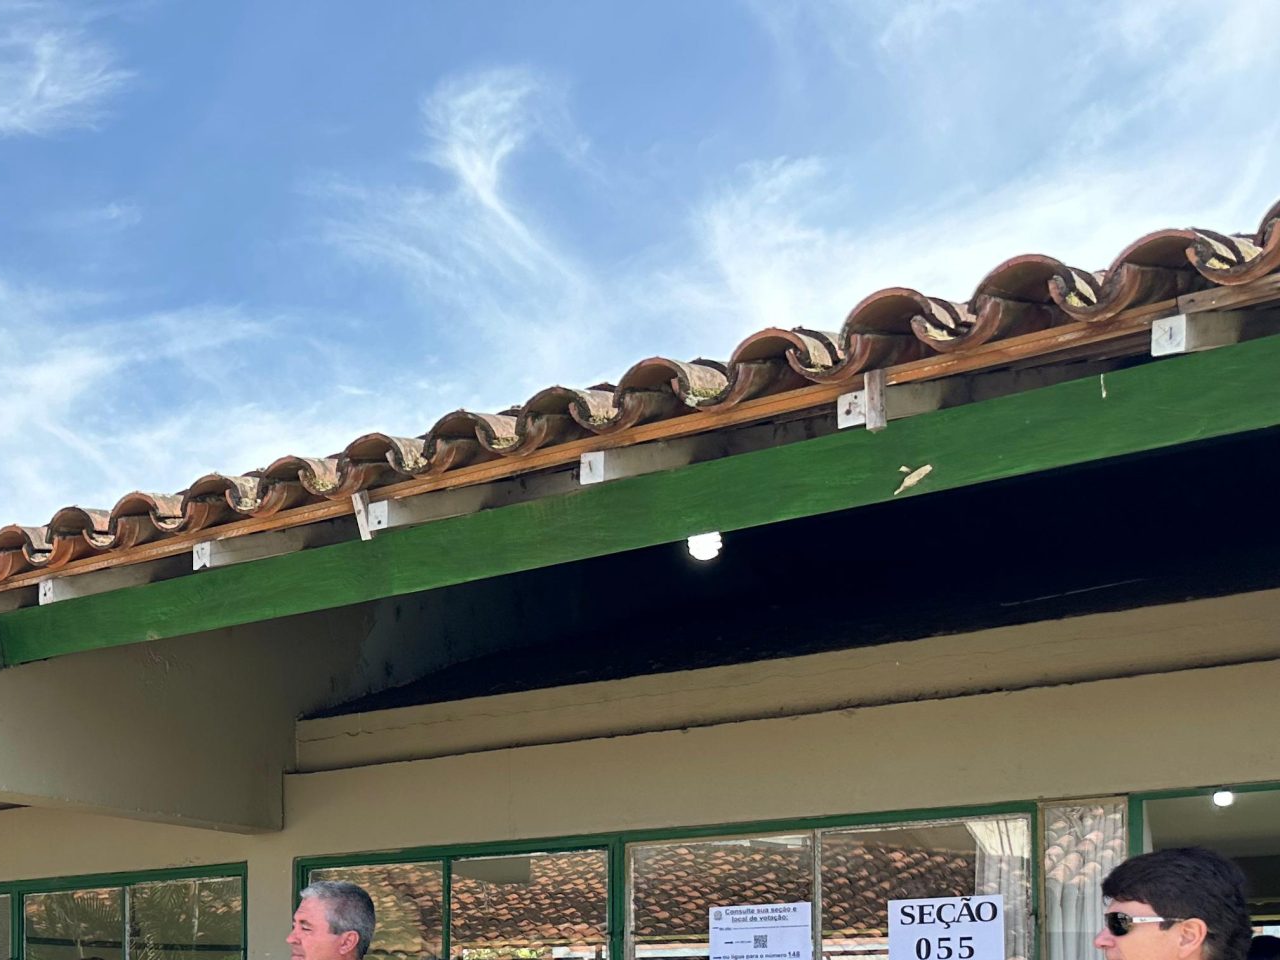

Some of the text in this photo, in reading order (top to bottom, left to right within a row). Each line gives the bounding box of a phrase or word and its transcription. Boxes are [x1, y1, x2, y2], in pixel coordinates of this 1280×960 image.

[771, 906, 791, 914] seção
[900, 897, 998, 929] SEÇÃO
[915, 936, 975, 960] 055
